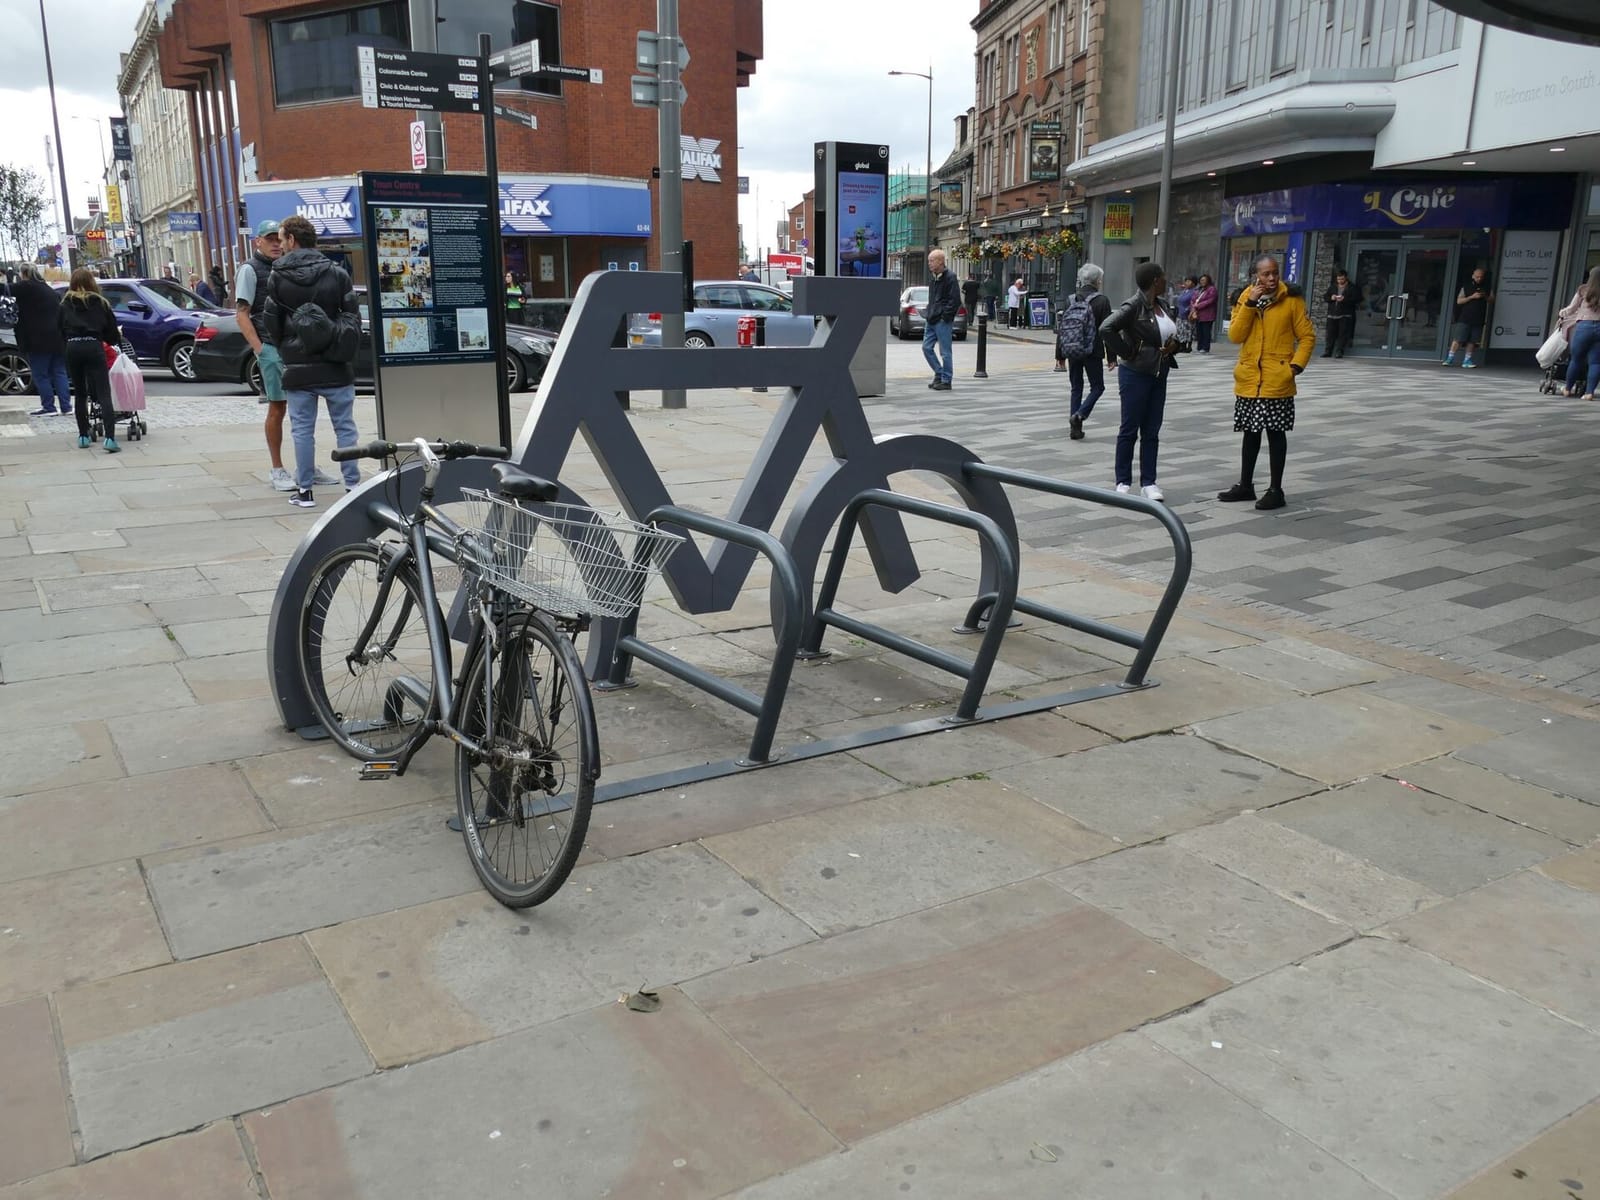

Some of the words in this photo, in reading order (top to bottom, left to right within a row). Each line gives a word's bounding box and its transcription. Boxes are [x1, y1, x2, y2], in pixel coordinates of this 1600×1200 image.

[296, 202, 352, 219] HALIFAX
[87, 230, 106, 238] CAFE
[1504, 249, 1522, 258] Unit
[1525, 249, 1536, 258] To
[1539, 249, 1553, 258] Let
